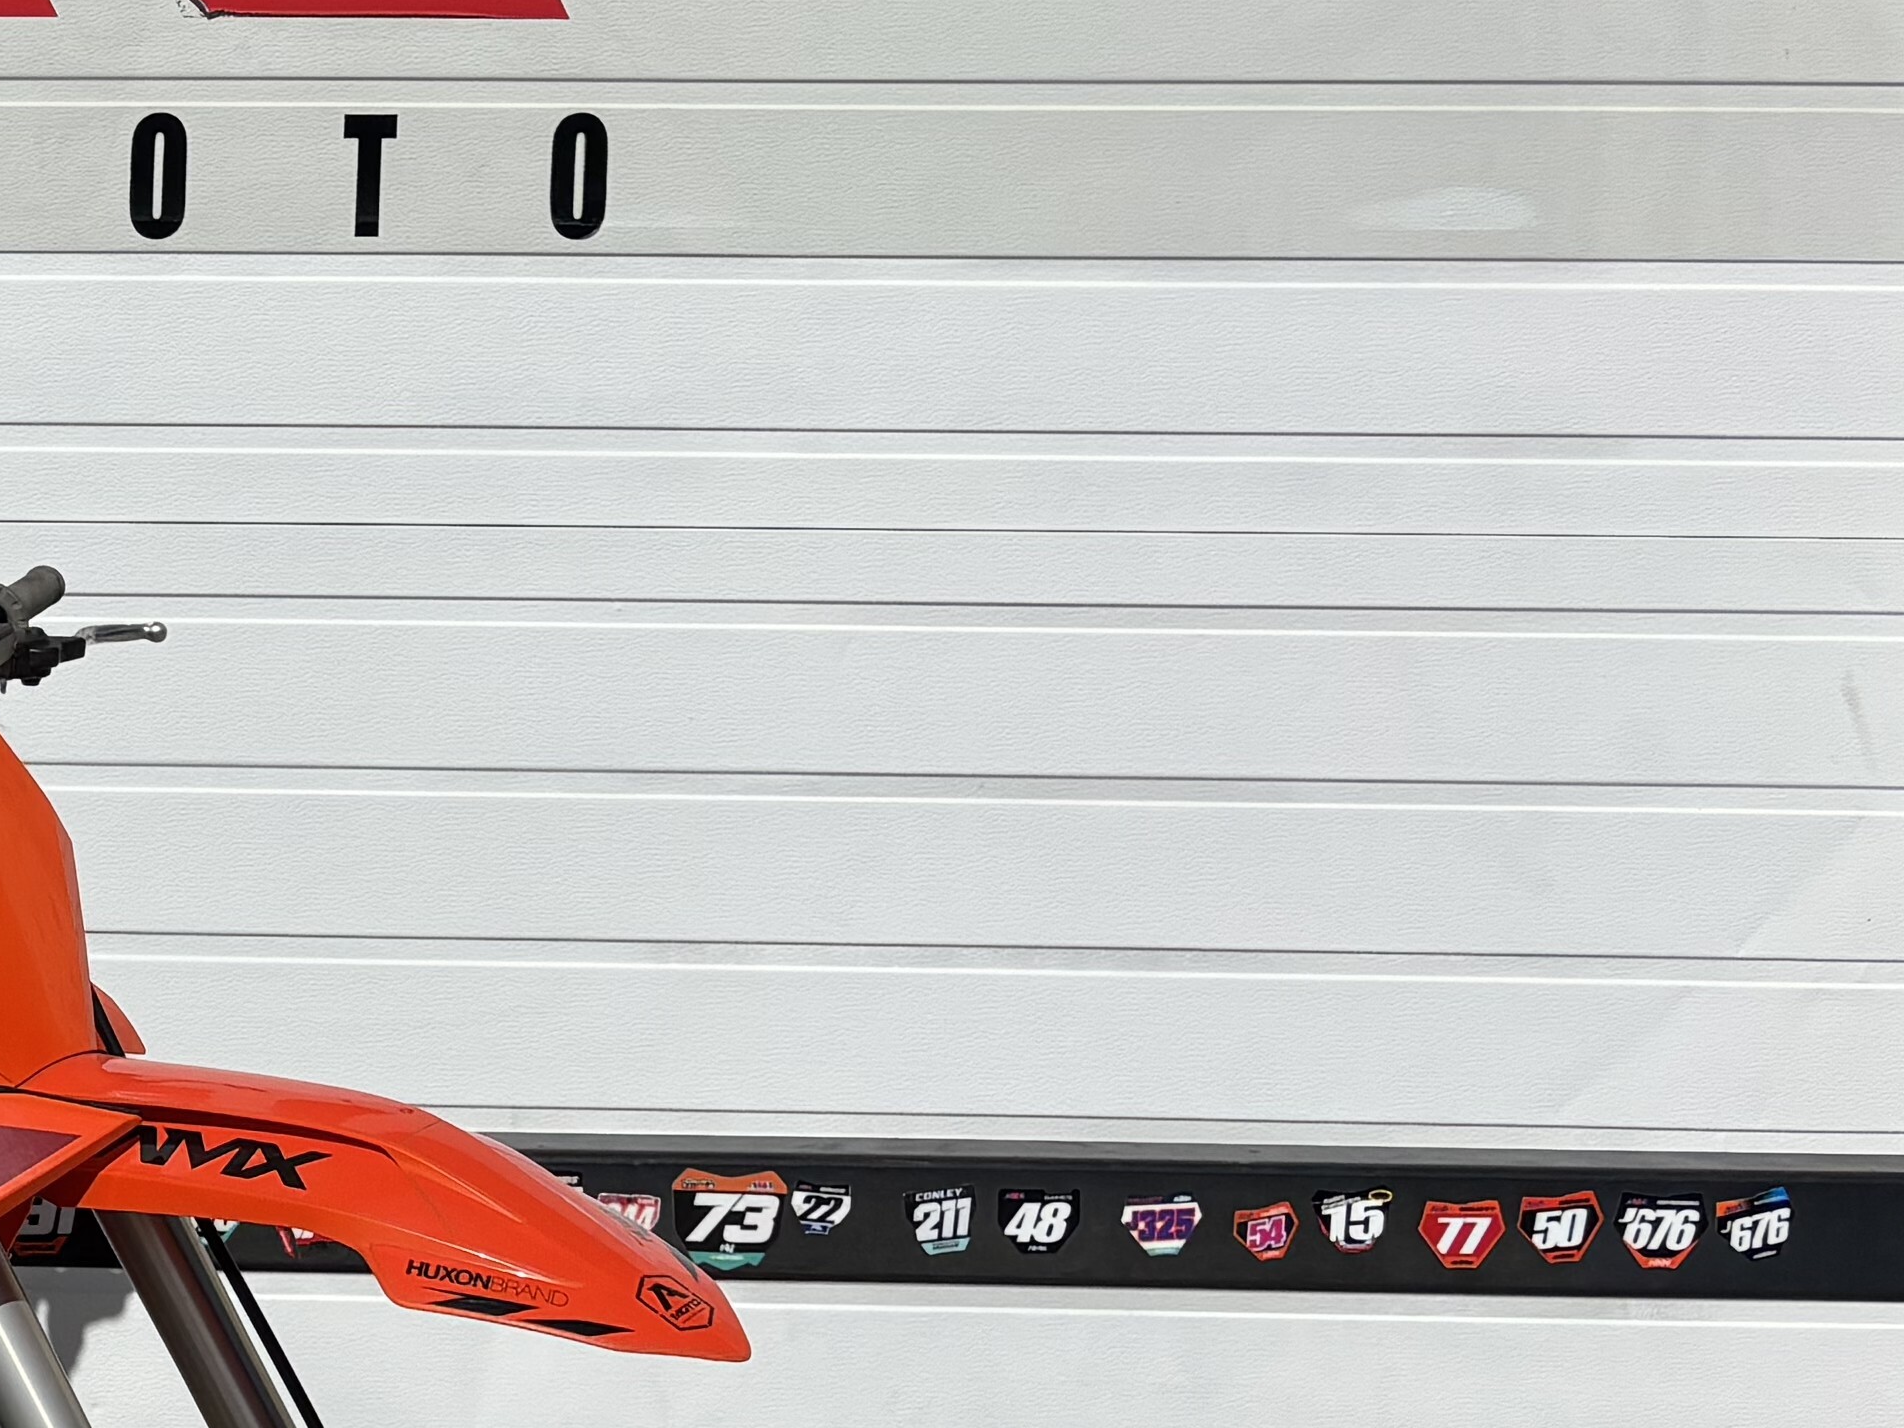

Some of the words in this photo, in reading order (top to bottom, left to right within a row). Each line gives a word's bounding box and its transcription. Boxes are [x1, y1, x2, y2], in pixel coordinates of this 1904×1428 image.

[798, 1194, 843, 1225] 22
[915, 1188, 963, 1202] CONLEY
[685, 1192, 780, 1243] 73
[913, 1197, 971, 1242] 211
[1004, 1202, 1071, 1243] 48
[1247, 1215, 1286, 1252] 54
[1322, 1199, 1385, 1243] 15
[1436, 1217, 1492, 1255] 77
[1532, 1208, 1587, 1250] 50
[405, 1259, 570, 1307] HUXONBRAND
